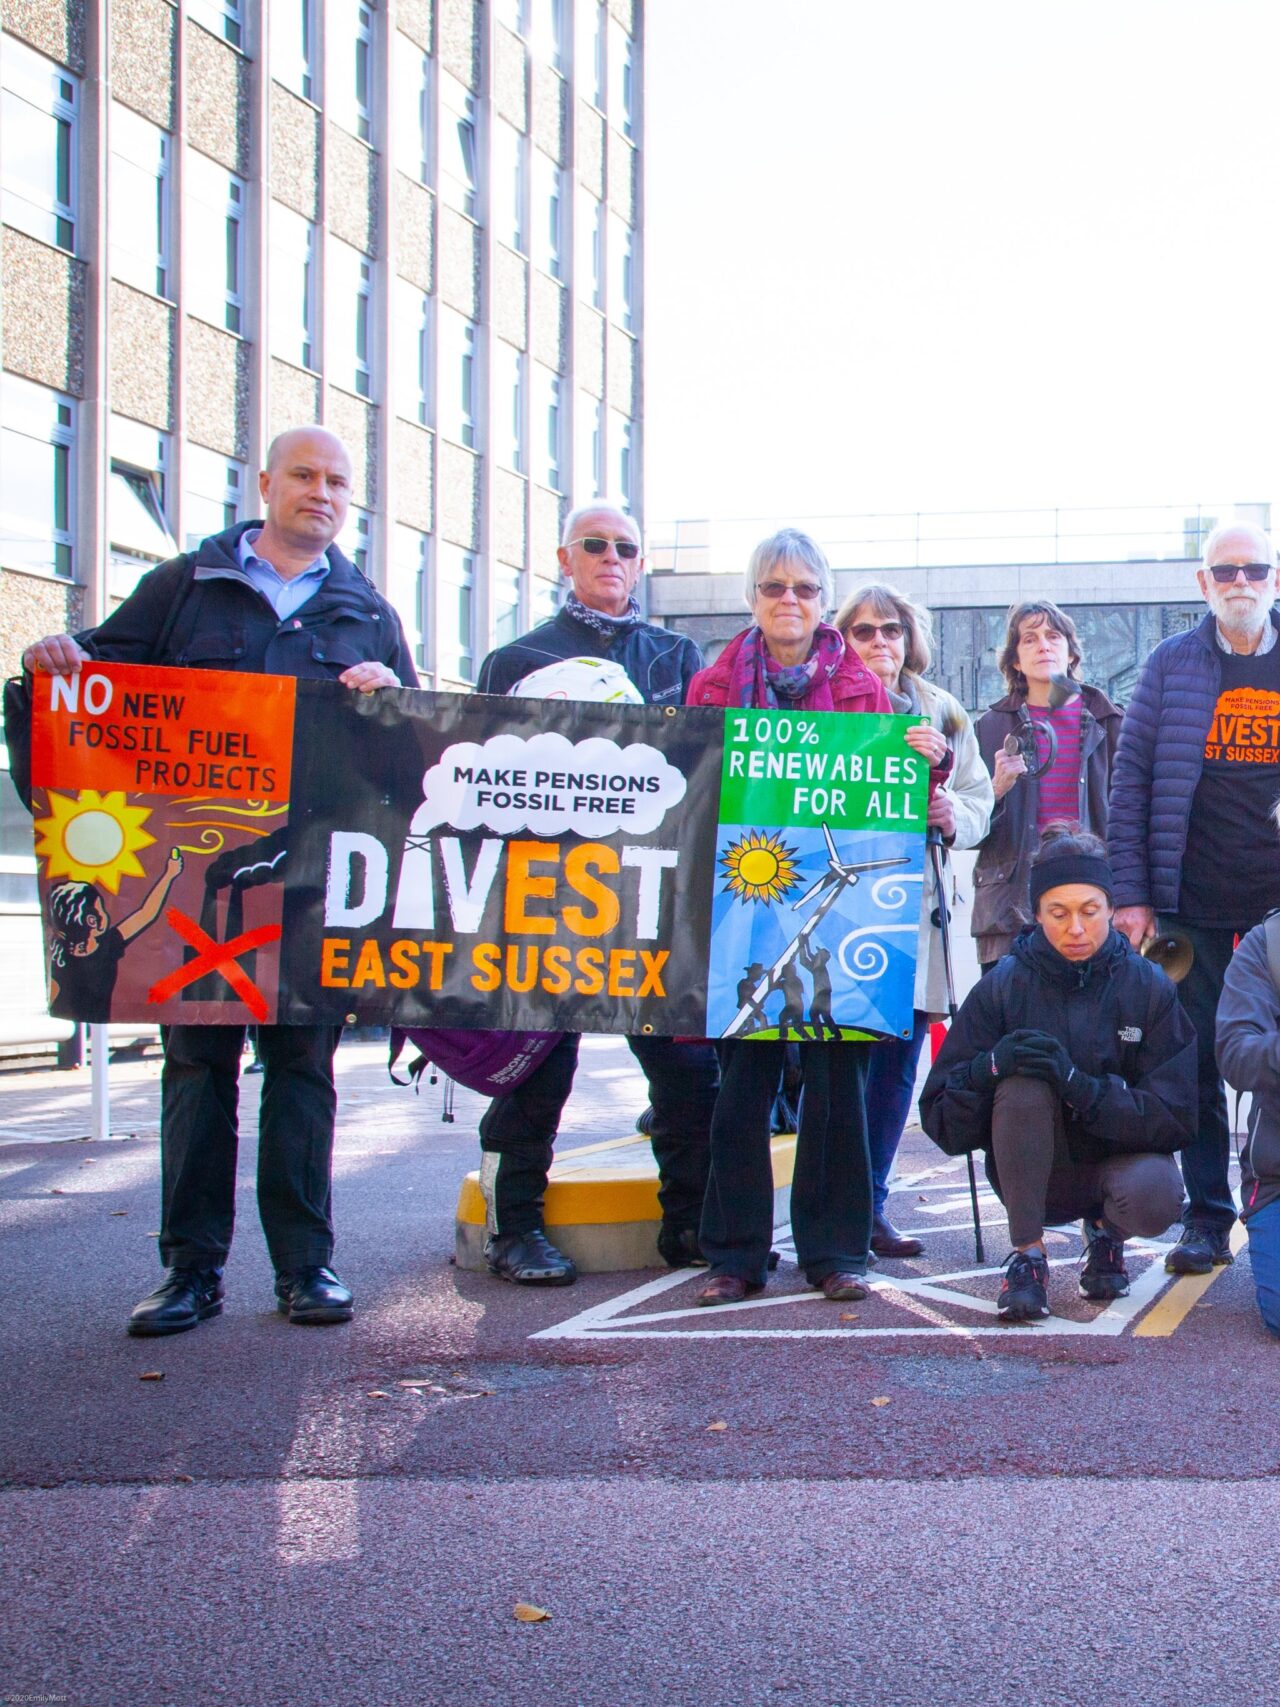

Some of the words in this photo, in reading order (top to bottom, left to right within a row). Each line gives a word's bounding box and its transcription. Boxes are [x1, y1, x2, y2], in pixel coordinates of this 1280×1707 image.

[50, 674, 114, 716] NO
[122, 693, 185, 720] NEW
[1225, 696, 1244, 704] MAKE
[1245, 697, 1280, 706] PENSIONS
[1230, 703, 1253, 711] FOSSIL
[69, 721, 171, 754] FOSSIL
[188, 729, 257, 759] FUEL
[733, 718, 820, 745] 100%
[729, 750, 918, 784] RENEWABLES
[1226, 746, 1280, 764] SUSSEX
[135, 760, 276, 793] PROJECTS
[454, 767, 526, 786] MAKE
[535, 772, 660, 792] PENSIONS
[477, 791, 565, 811] FOSSIL
[573, 796, 635, 814] FREE
[793, 787, 847, 817] FOR
[866, 791, 919, 820] ALL
[324, 830, 679, 941] DIVEST
[320, 937, 453, 991] EAST
[470, 943, 670, 998] SUSSEX
[486, 1053, 524, 1082] UNISON
[495, 1074, 510, 1085] 25
